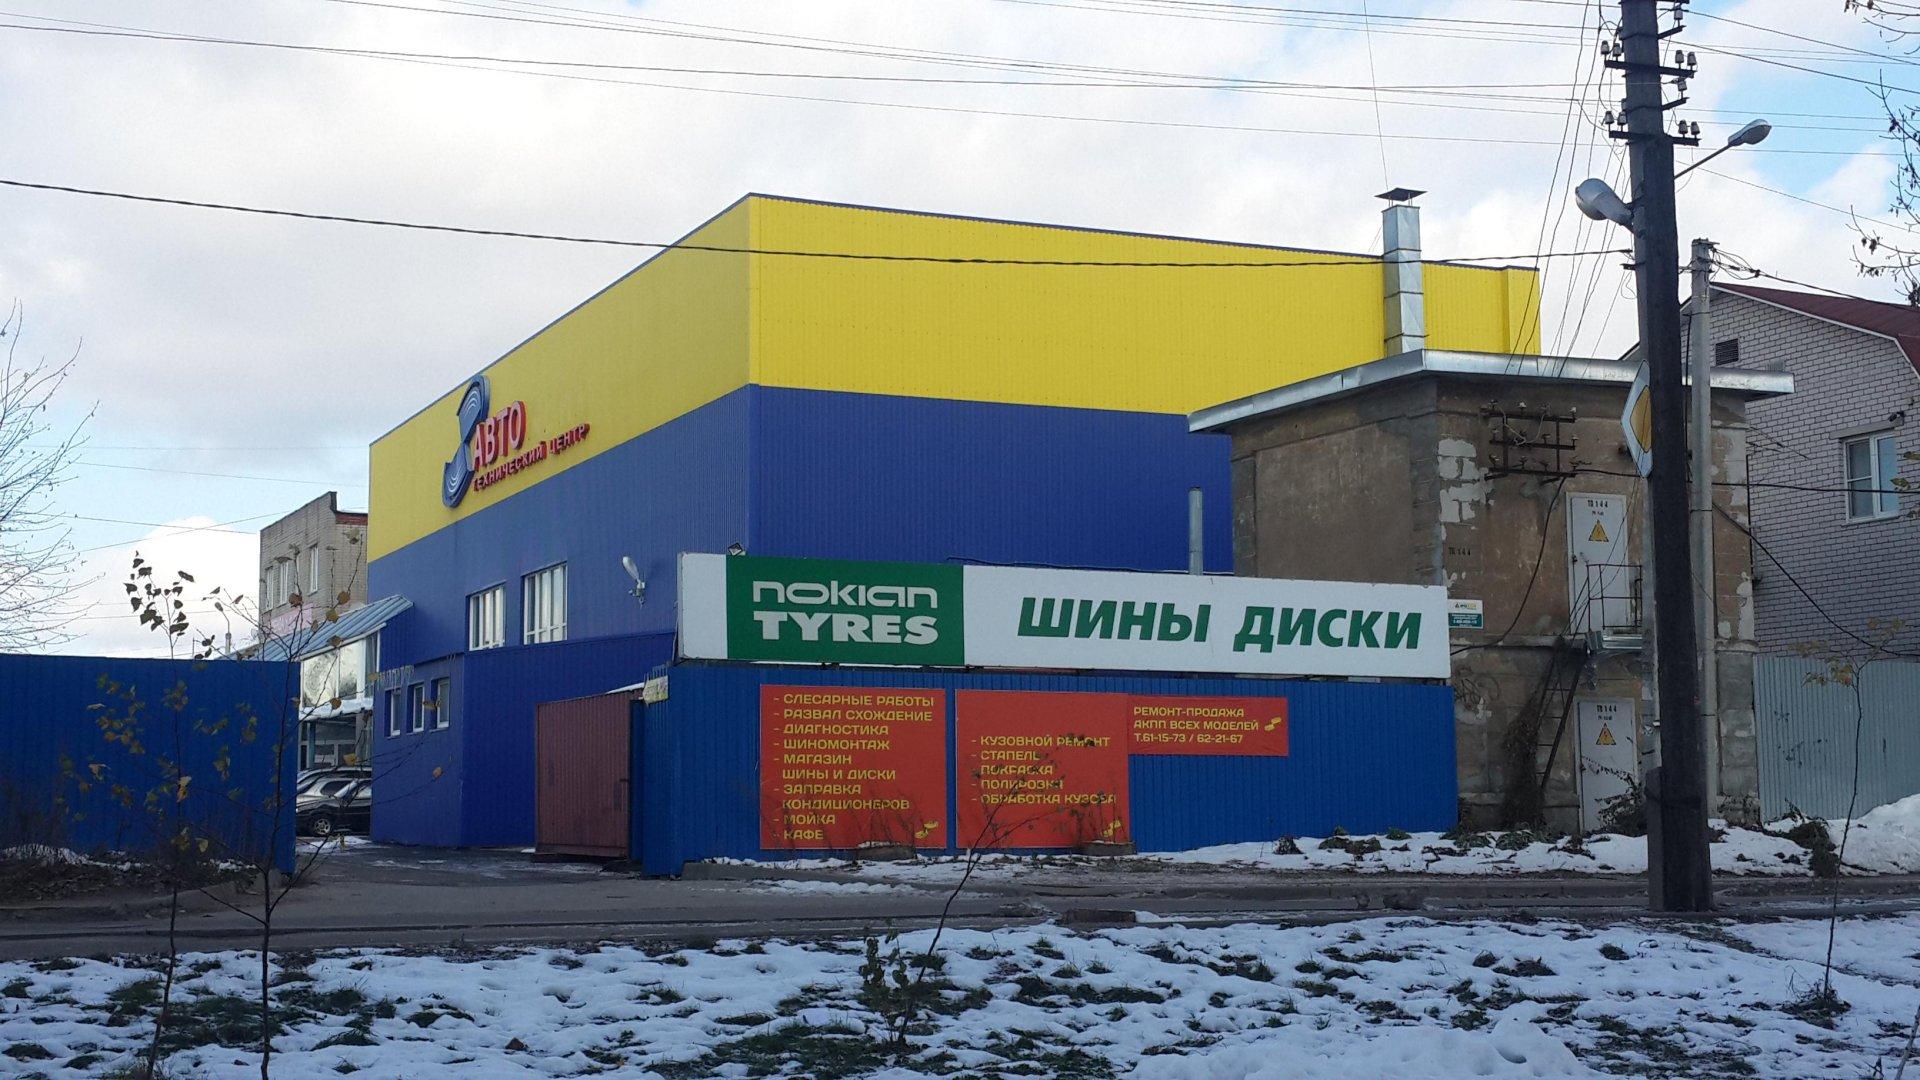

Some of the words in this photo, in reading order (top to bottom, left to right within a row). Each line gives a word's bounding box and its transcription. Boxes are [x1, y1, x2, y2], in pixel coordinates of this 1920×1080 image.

[473, 400, 527, 472] АВТО
[473, 440, 547, 492] ТЕХНИЧЕСКИЙ
[550, 423, 591, 455] ЦЕНТР
[753, 610, 939, 645] TYRES
[1017, 597, 1212, 642] ШИНЫ
[1232, 605, 1422, 653] ДИСКИ
[783, 693, 872, 706] СЛЕСАРНЫЕ
[876, 695, 934, 707] РАБОТЫ
[783, 708, 842, 720] РАЗВАЛ
[845, 709, 933, 722] СХОЖДЕНИЕ
[1133, 706, 1244, 718] РЕМОНТ-ПРОДАЖА
[783, 723, 889, 735] ДИАГНОСТИКА
[1133, 719, 1167, 729] АКПП
[1169, 720, 1200, 730] ВСЕХ
[1203, 719, 1259, 731] МОДЕЛЕЙ
[980, 735, 1053, 747] КУЗОВНОЙ
[1056, 736, 1110, 747] РЕМОНТ
[1134, 732, 1186, 742] Т.61-15-73
[1196, 733, 1244, 744] 62-21-67
[783, 739, 890, 750] ШИНОМОНТАЖ
[783, 754, 852, 765] МАГАЗИН
[980, 750, 1040, 761] СТАПЕЛЬ
[782, 769, 829, 780] ШИНЫ
[833, 769, 843, 780] И
[847, 769, 896, 781] ДИСКИ
[980, 765, 1053, 775] ПОКРАСКА
[783, 784, 862, 795] ЗАПРАВКА
[782, 799, 910, 810] КОНДИЦИОНЕРОВ
[980, 794, 1061, 804] ОБРАБОТКА
[783, 812, 836, 825] МОЙКА
[783, 829, 824, 840] КАФЕ
